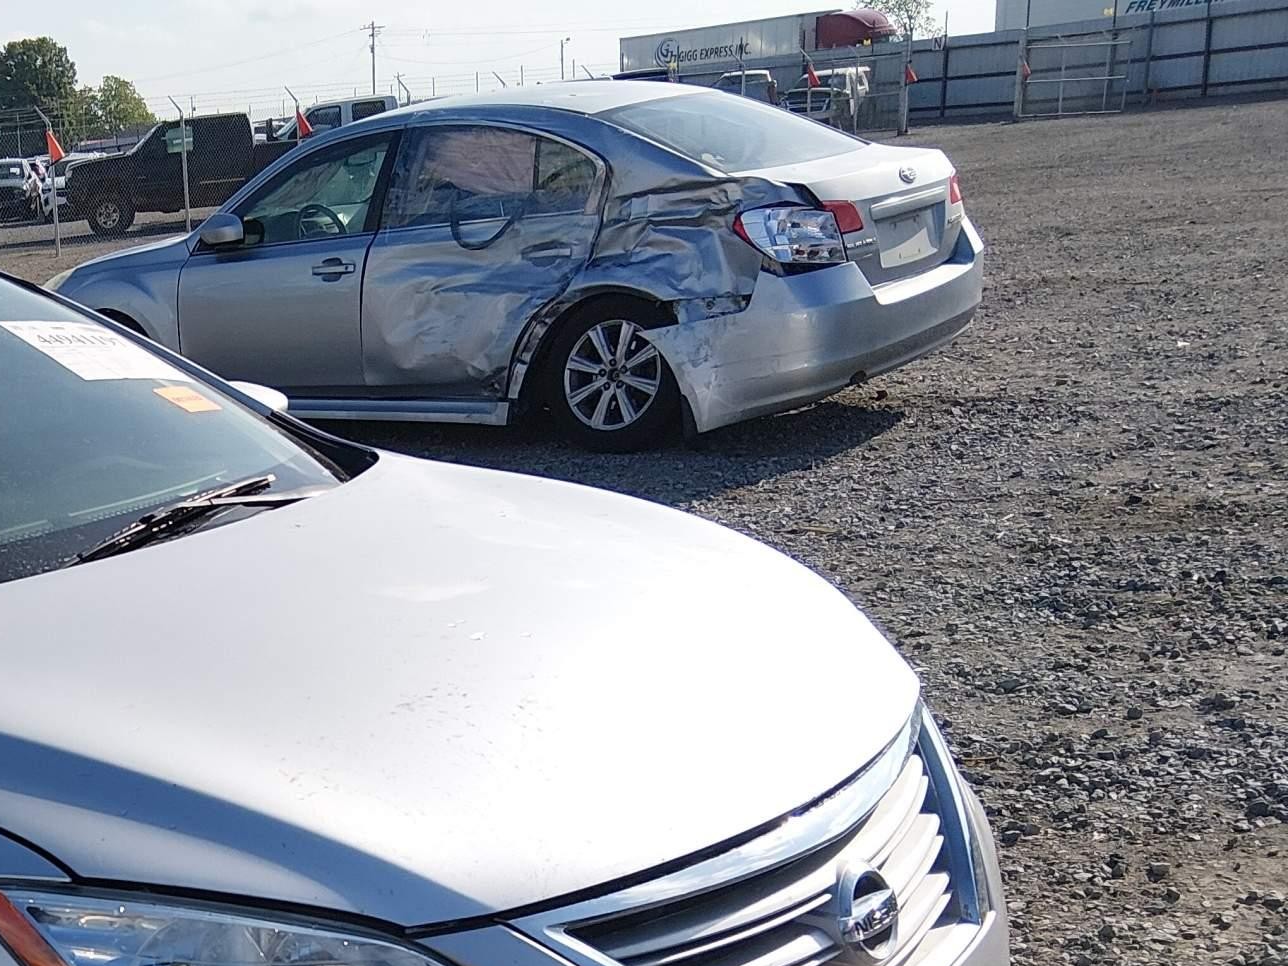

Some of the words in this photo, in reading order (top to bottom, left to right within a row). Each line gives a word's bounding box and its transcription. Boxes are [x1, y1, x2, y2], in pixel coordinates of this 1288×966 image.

[1125, 0, 1225, 14] FREYMI
[679, 48, 698, 62] GIGG
[699, 44, 734, 61] EXPRESS
